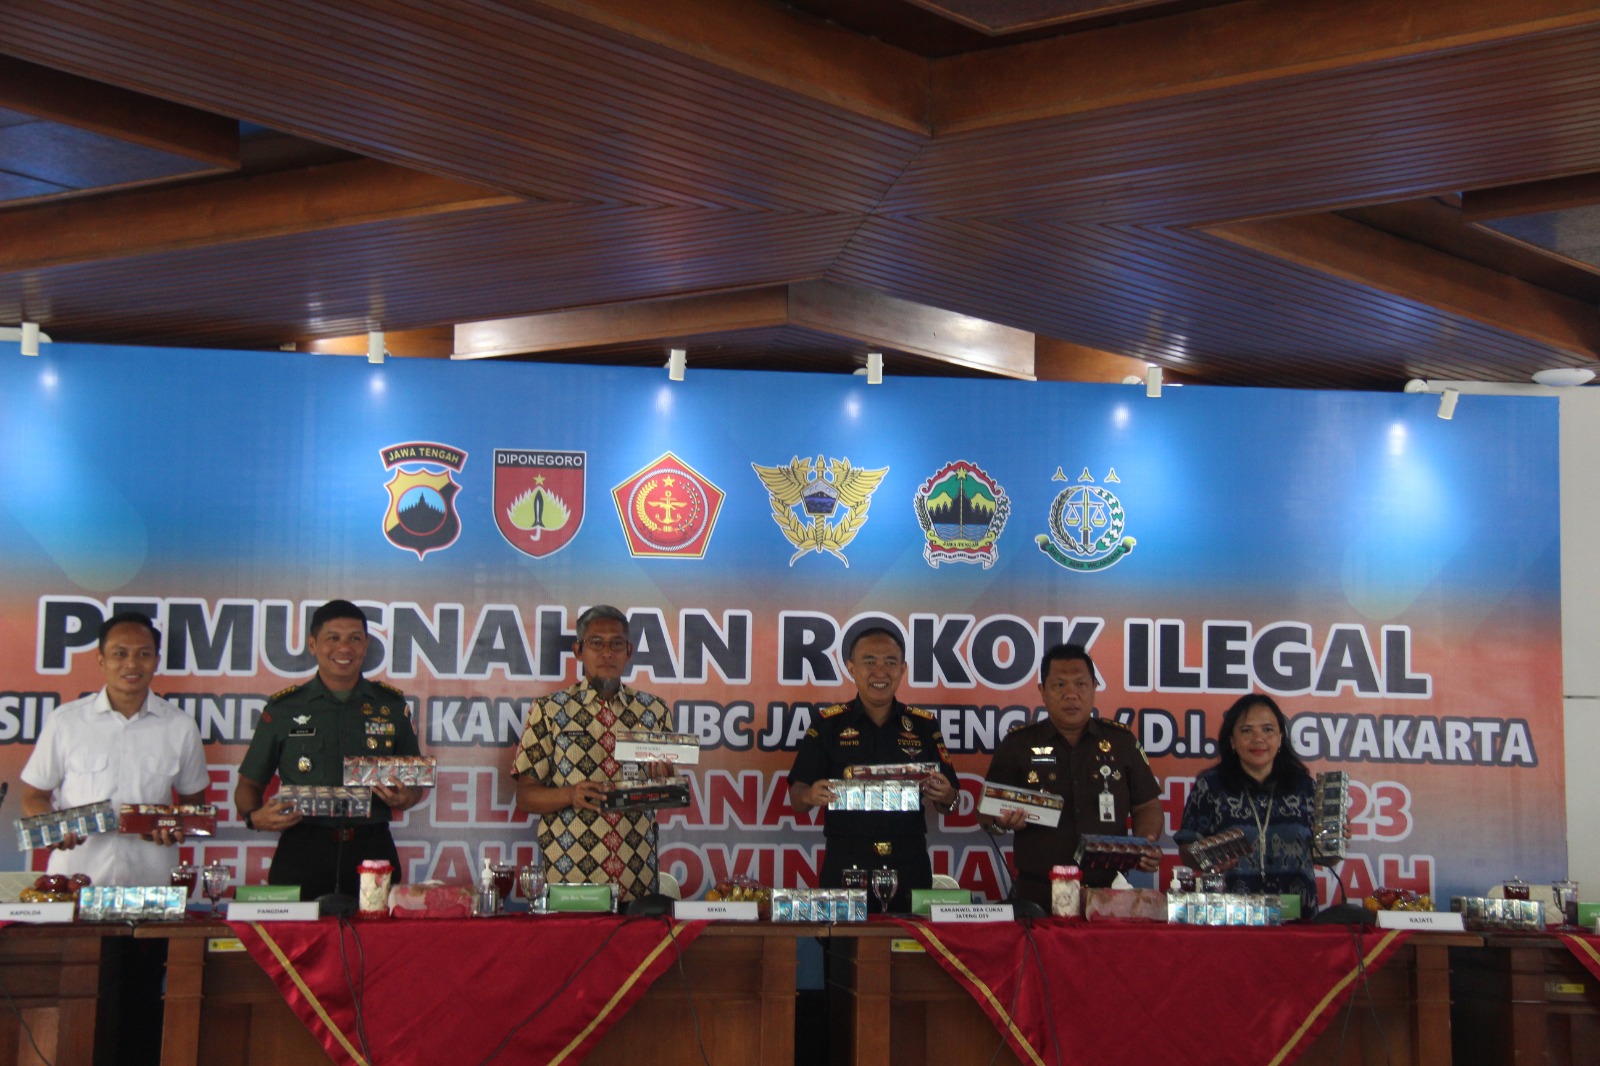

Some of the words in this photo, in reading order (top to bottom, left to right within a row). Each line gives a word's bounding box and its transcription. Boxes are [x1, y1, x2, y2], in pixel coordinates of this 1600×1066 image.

[388, 448, 417, 462] JAWA
[418, 447, 460, 465] TENGAH
[497, 453, 583, 467] DIPONEGORO
[38, 597, 751, 684] PMUSNAHAN
[1125, 618, 1431, 698] ILEGAL
[0, 697, 55, 741] SI
[1144, 713, 1216, 755] D.I.
[1287, 716, 1534, 764] GYAKARTA
[1347, 785, 1408, 838] 23
